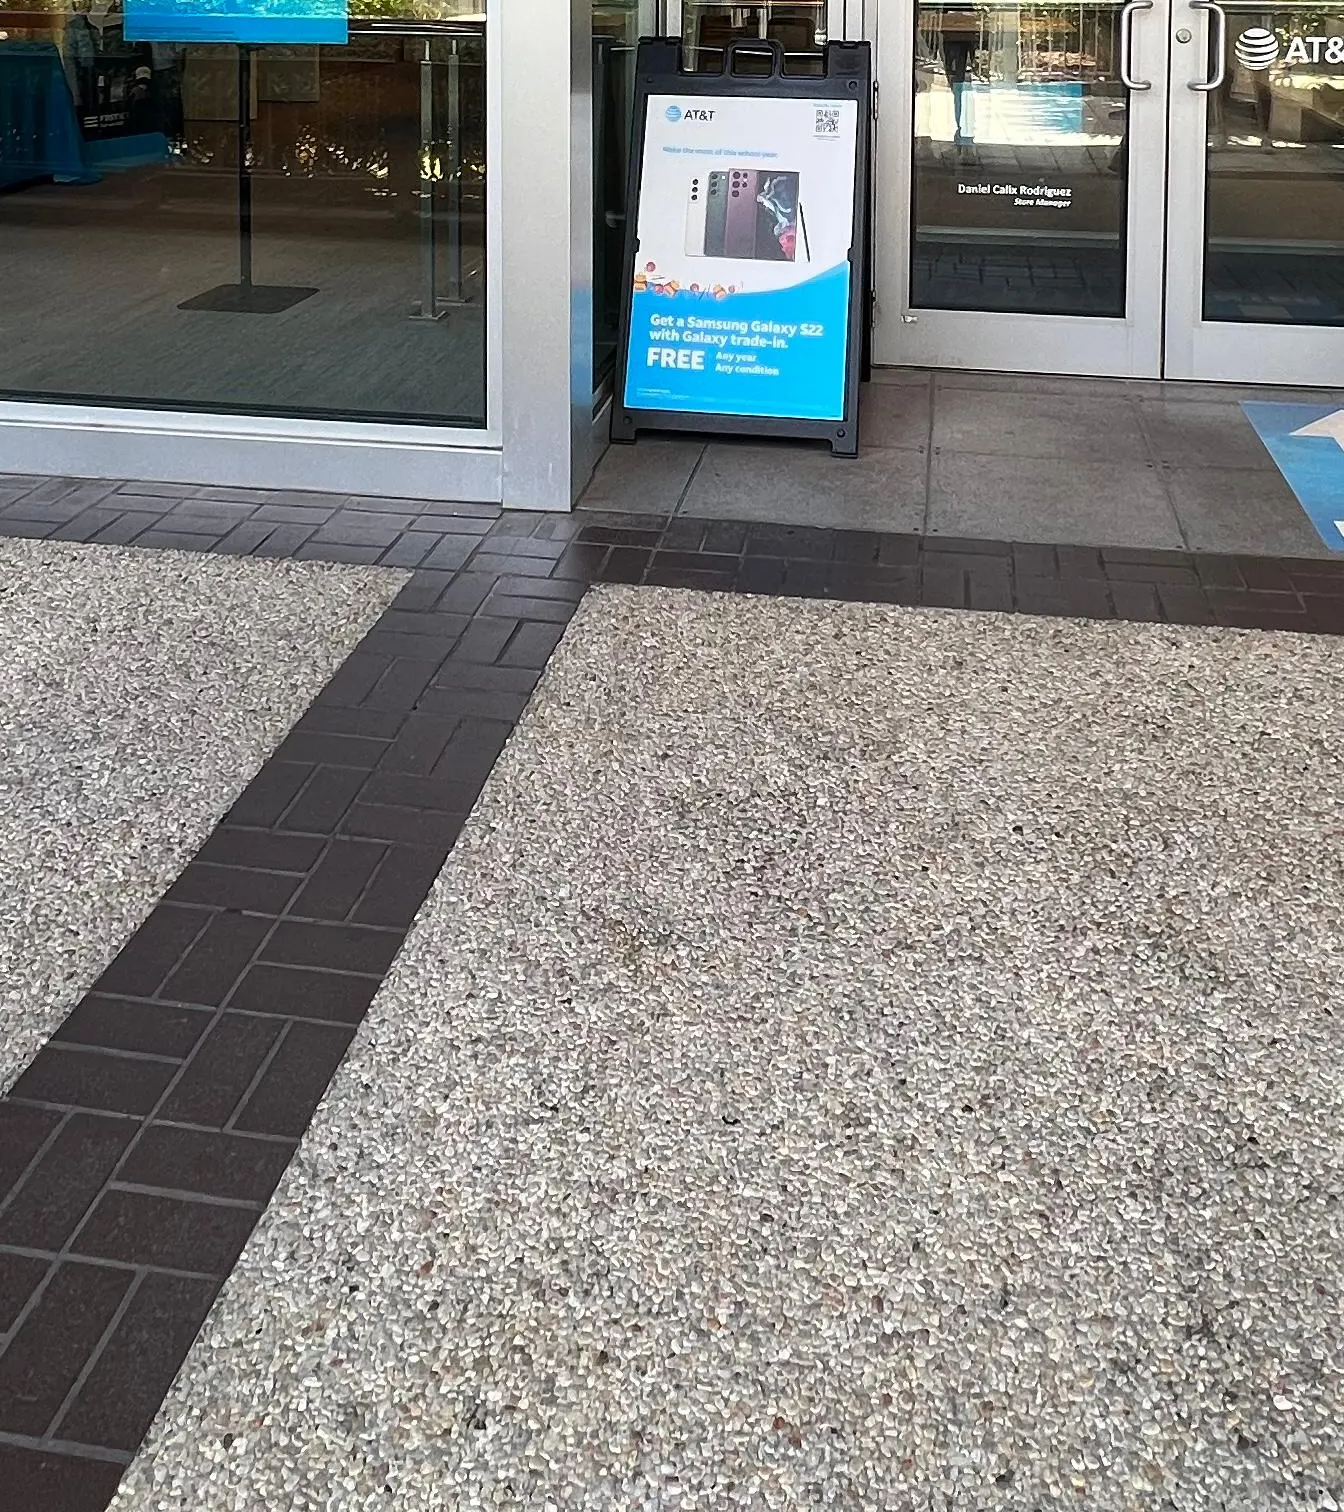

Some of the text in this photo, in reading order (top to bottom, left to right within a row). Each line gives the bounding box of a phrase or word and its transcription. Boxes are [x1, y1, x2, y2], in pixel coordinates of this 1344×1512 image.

[684, 109, 716, 122] AT&T
[957, 183, 1072, 198] Daniel Calix Rodriguez
[649, 313, 824, 338] Get a Samsung Galaxy S22
[649, 328, 789, 349] with Galaxy trade-in.
[646, 346, 706, 371] FREE
[715, 351, 758, 363] Any year
[715, 363, 780, 376] Any condition
